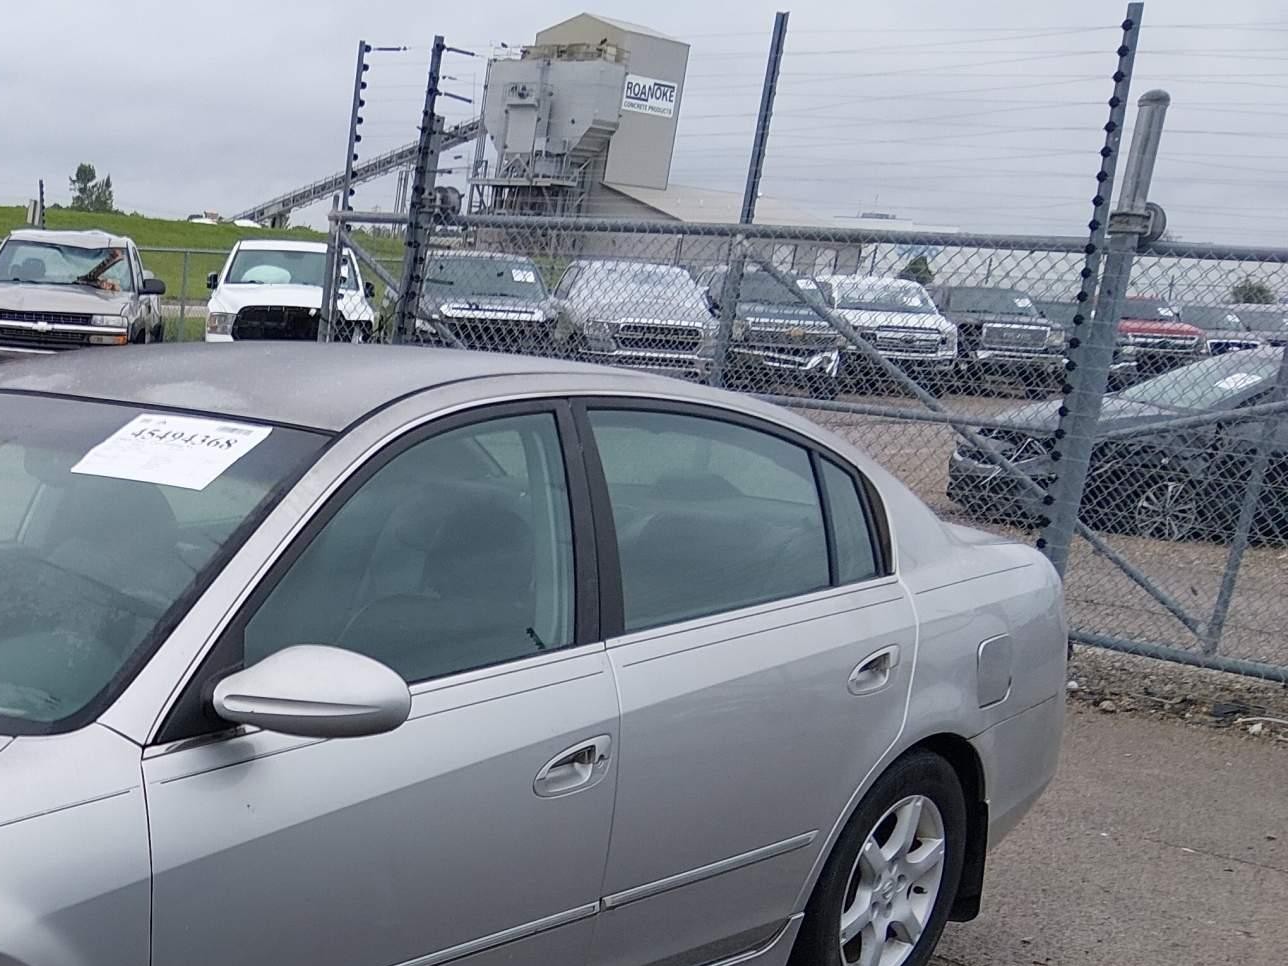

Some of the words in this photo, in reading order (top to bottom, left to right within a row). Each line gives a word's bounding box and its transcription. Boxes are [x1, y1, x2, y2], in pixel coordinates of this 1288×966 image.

[625, 81, 675, 102] ROANOKE
[623, 100, 648, 111] CONCRETE
[648, 105, 672, 116] PRODUCTS
[131, 427, 239, 450] 45494368
